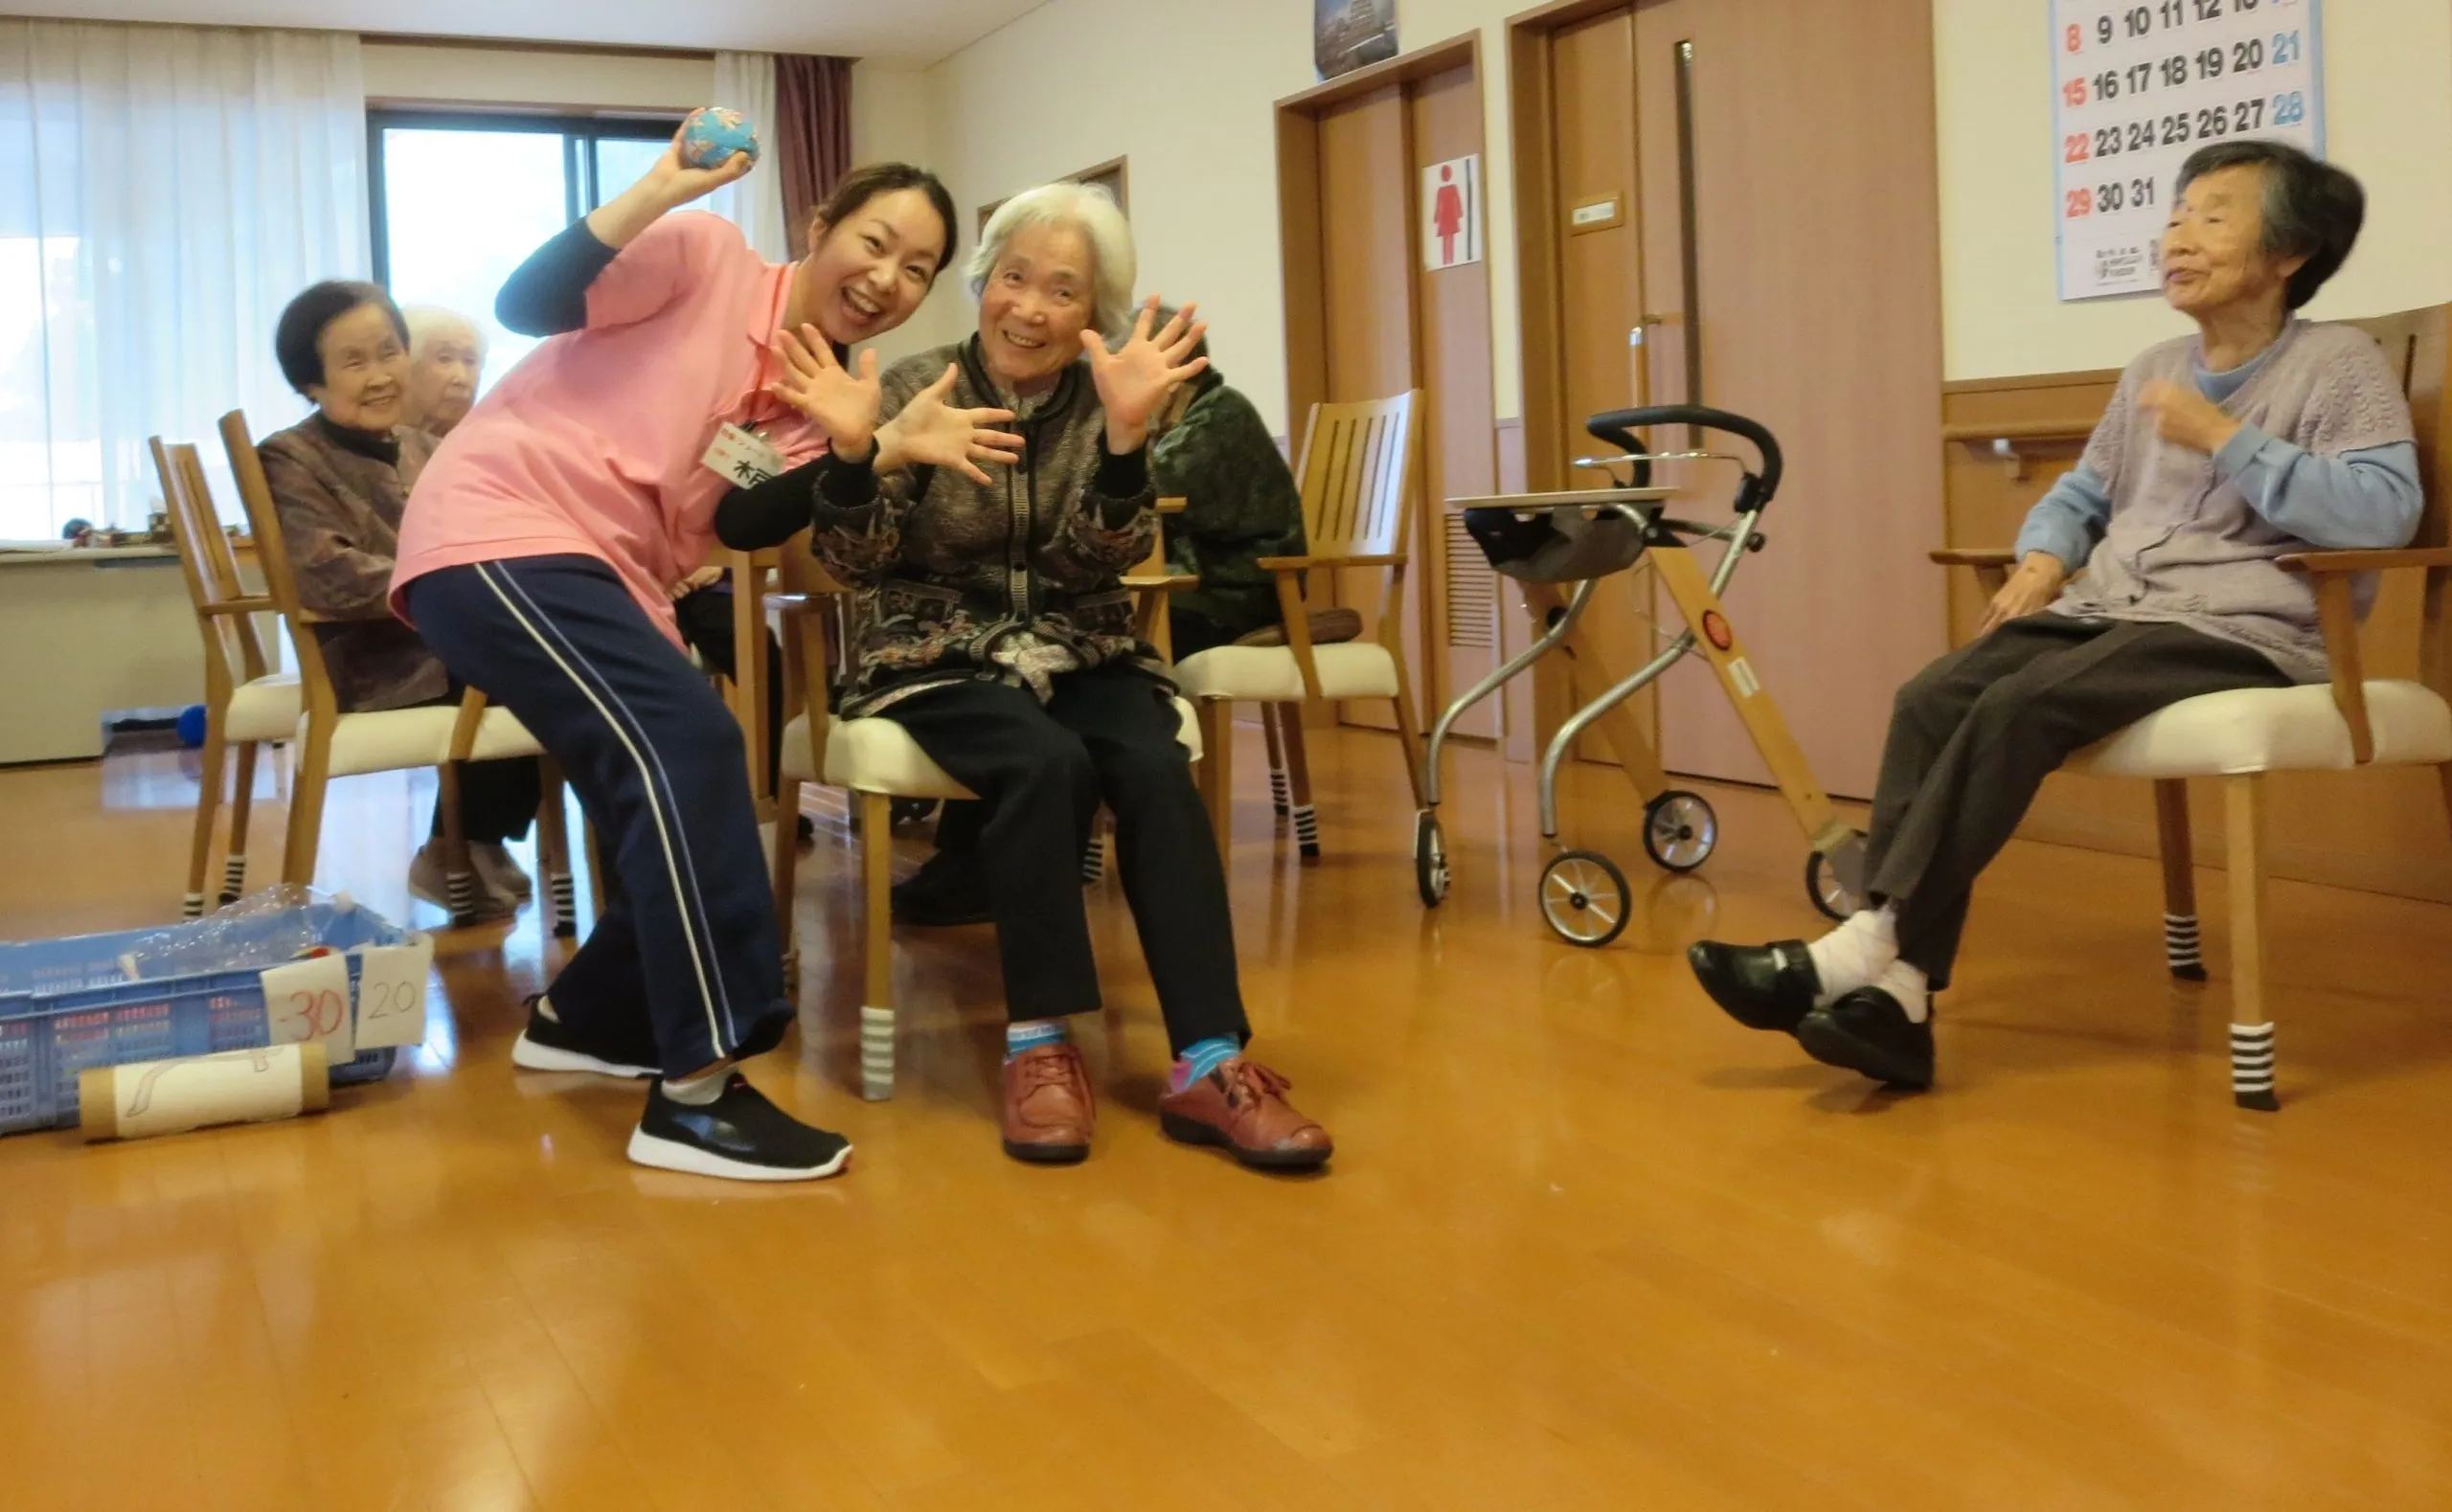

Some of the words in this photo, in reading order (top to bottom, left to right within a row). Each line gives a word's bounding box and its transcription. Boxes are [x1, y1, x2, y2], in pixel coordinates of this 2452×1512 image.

[2066, 24, 2081, 52] 8
[2097, 15, 2113, 44] 9
[2123, 6, 2150, 37] 10
[2160, 0, 2184, 29] 11
[2191, 0, 2221, 21] 12
[2062, 78, 2087, 107] 15
[2093, 71, 2120, 101] 16
[2125, 62, 2152, 94] 17
[2159, 56, 2188, 87] 18
[2194, 48, 2224, 80] 19
[2233, 38, 2263, 73] 20
[2271, 30, 2300, 64] 21
[2065, 132, 2090, 163] 22
[2095, 125, 2122, 157] 23
[2127, 120, 2155, 151] 24
[2161, 112, 2191, 145] 25
[2196, 105, 2228, 139] 26
[2234, 98, 2265, 132] 27
[2272, 91, 2304, 125] 28
[2066, 189, 2092, 216] 29
[2097, 182, 2123, 213] 30
[2130, 176, 2155, 207] 31
[369, 981, 416, 1020] 20
